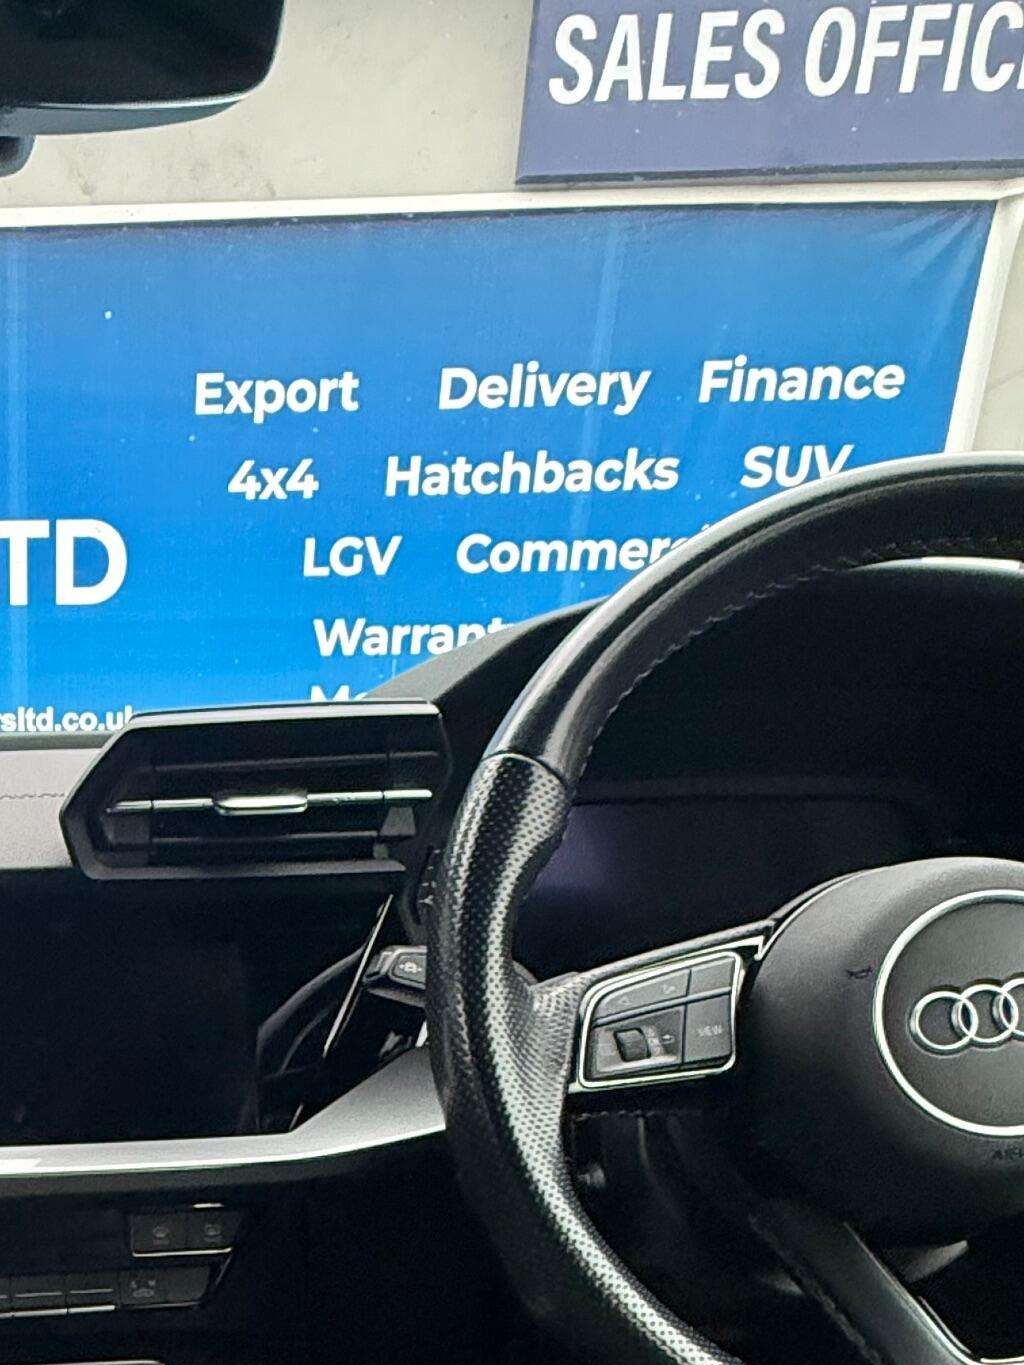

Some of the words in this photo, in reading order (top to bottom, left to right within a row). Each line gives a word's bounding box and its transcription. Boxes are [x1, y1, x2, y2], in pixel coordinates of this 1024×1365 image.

[547, 8, 784, 105] SALES
[803, 0, 1024, 98] OFFIC
[194, 371, 360, 425] Export
[438, 360, 652, 416] Delivery
[698, 354, 906, 404] Finance
[227, 458, 320, 501] 4x4
[385, 448, 680, 498] Hatchbacks
[740, 444, 855, 489] SUV
[302, 535, 403, 577] LGV
[456, 524, 710, 575] Commer
[313, 616, 514, 657] Warran
